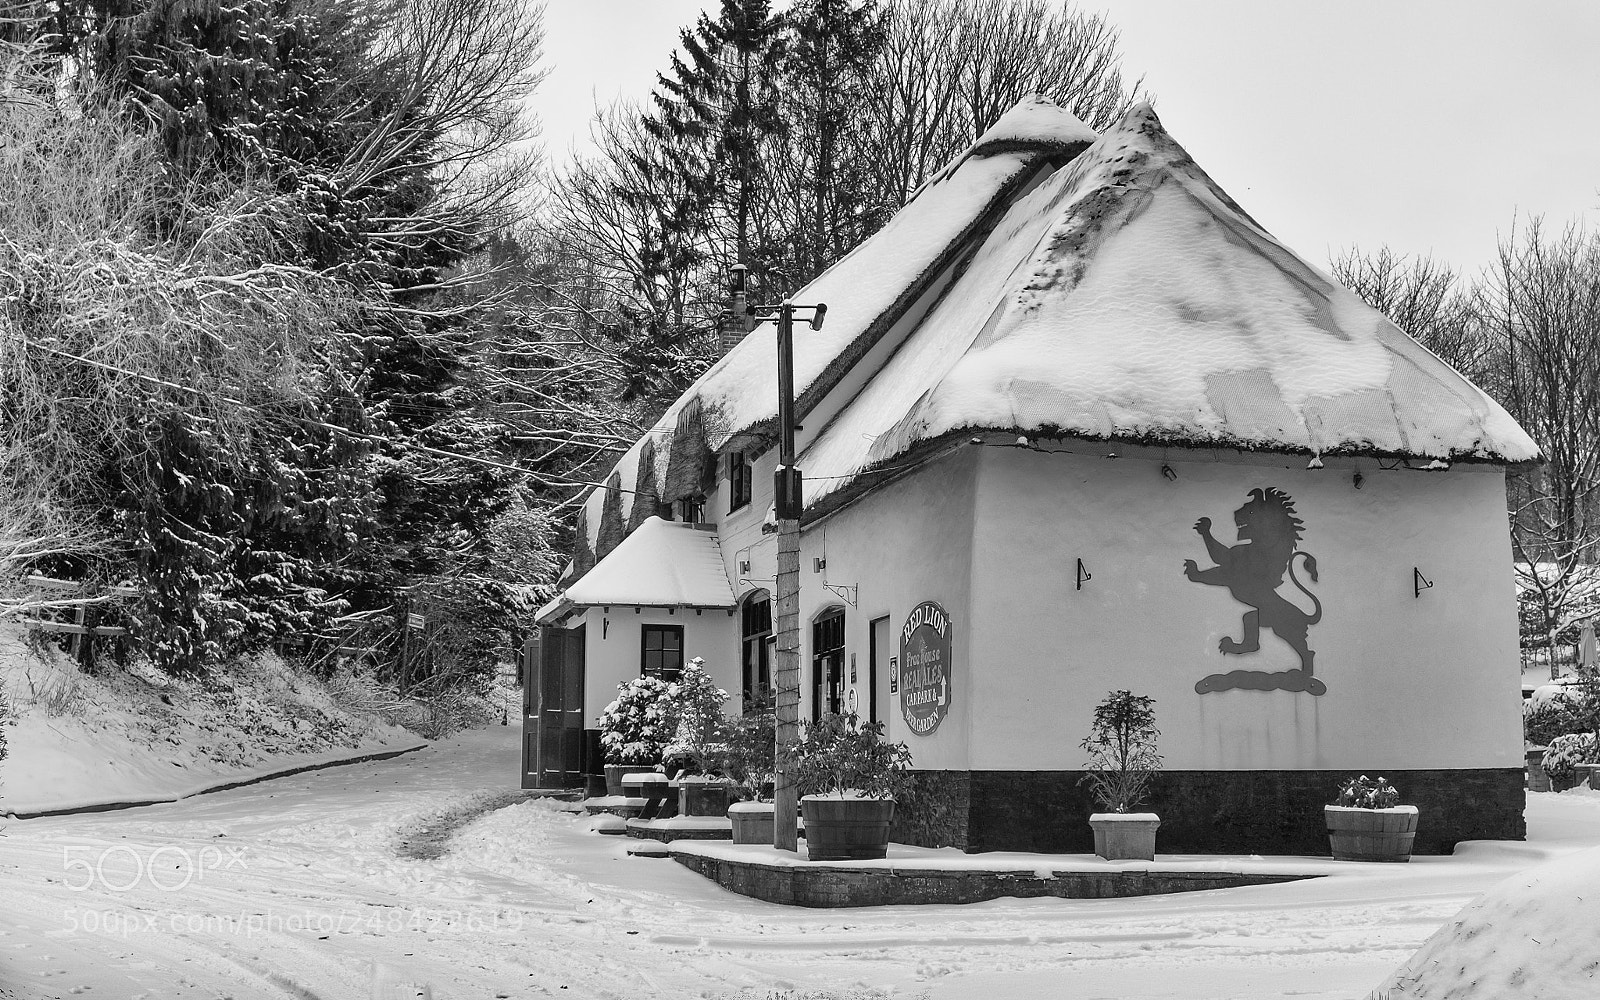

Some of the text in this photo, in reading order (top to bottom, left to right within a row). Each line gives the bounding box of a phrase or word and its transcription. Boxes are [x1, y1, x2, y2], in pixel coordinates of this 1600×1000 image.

[903, 605, 948, 645] RED LION
[903, 669, 922, 691] REAL
[922, 664, 943, 687] ALES
[916, 706, 939, 732] GARDEN
